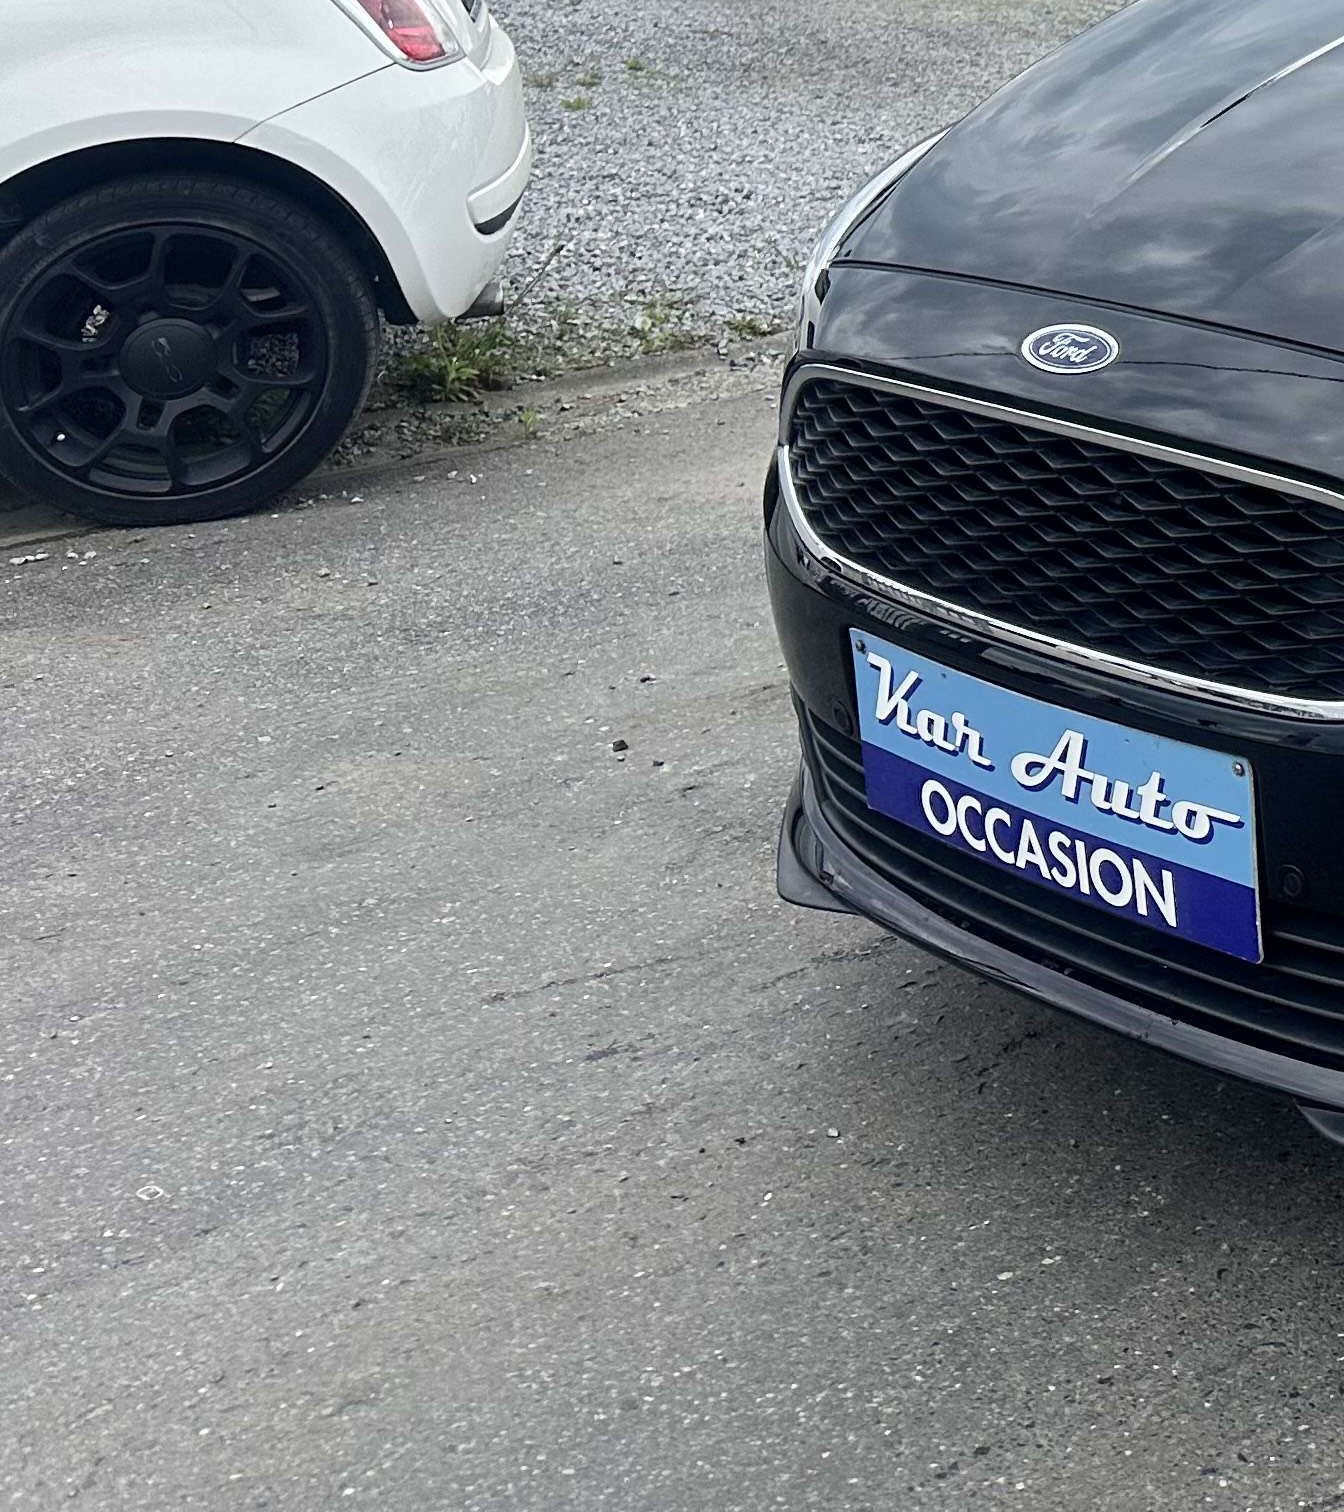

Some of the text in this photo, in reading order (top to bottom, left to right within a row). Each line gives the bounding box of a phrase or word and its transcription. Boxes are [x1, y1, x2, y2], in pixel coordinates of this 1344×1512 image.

[1038, 332, 1098, 363] Ford
[866, 651, 1243, 842] Kar Auto
[920, 778, 1178, 928] OCCASION
